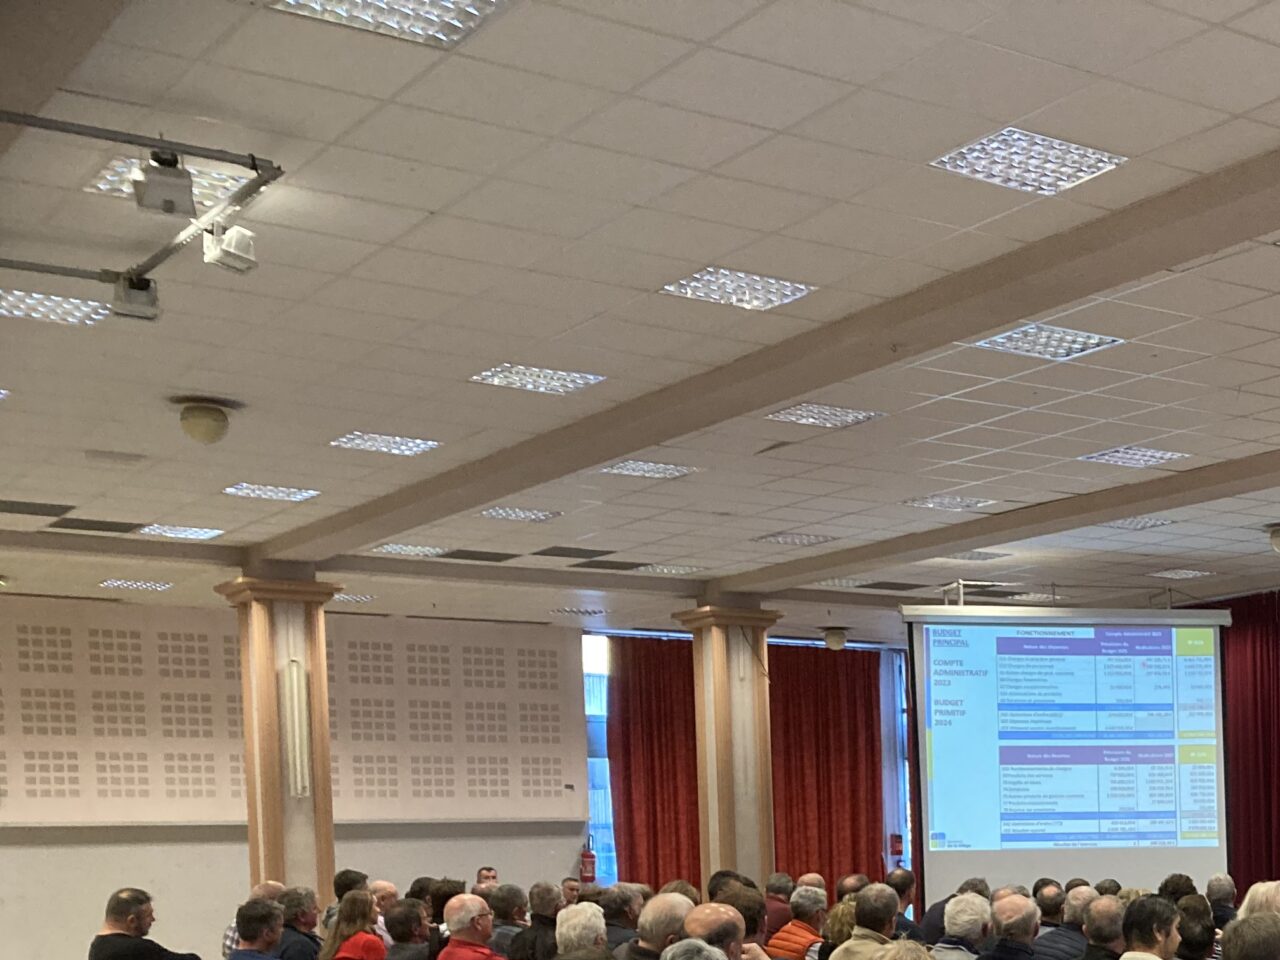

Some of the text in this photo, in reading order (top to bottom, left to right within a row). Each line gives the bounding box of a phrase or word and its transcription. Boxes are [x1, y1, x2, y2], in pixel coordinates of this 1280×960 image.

[933, 659, 964, 667] COMPTE
[933, 669, 988, 677] ADMINISTRATIF
[934, 699, 964, 707] BUDGET
[934, 709, 967, 717] PRIMITIF
